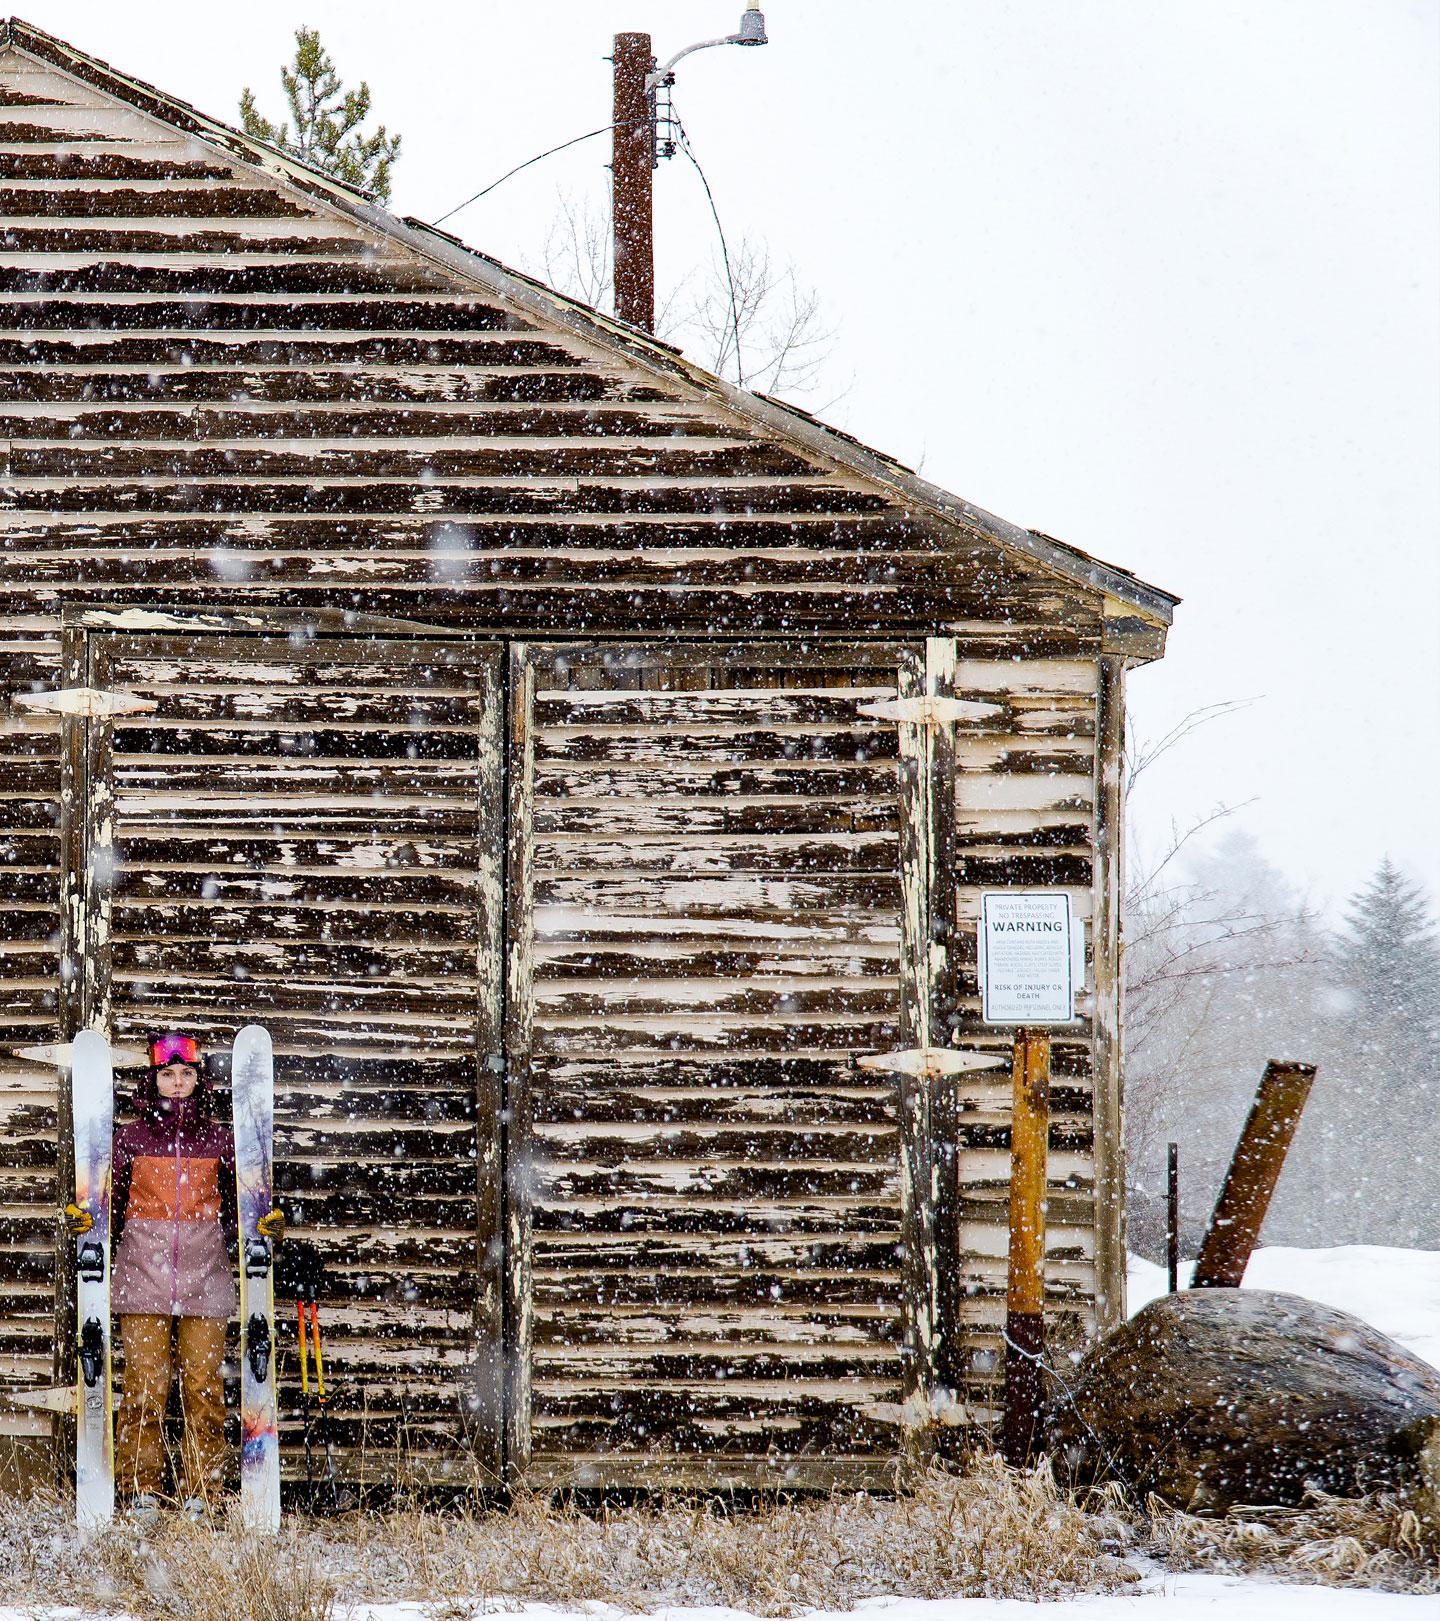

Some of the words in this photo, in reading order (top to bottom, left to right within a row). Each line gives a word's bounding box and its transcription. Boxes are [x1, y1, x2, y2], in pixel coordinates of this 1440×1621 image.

[994, 903, 1022, 911] PRIVATE
[1023, 903, 1058, 911] PROPERTY
[992, 921, 1062, 932] WARNING
[1016, 992, 1040, 1000] DEATH
